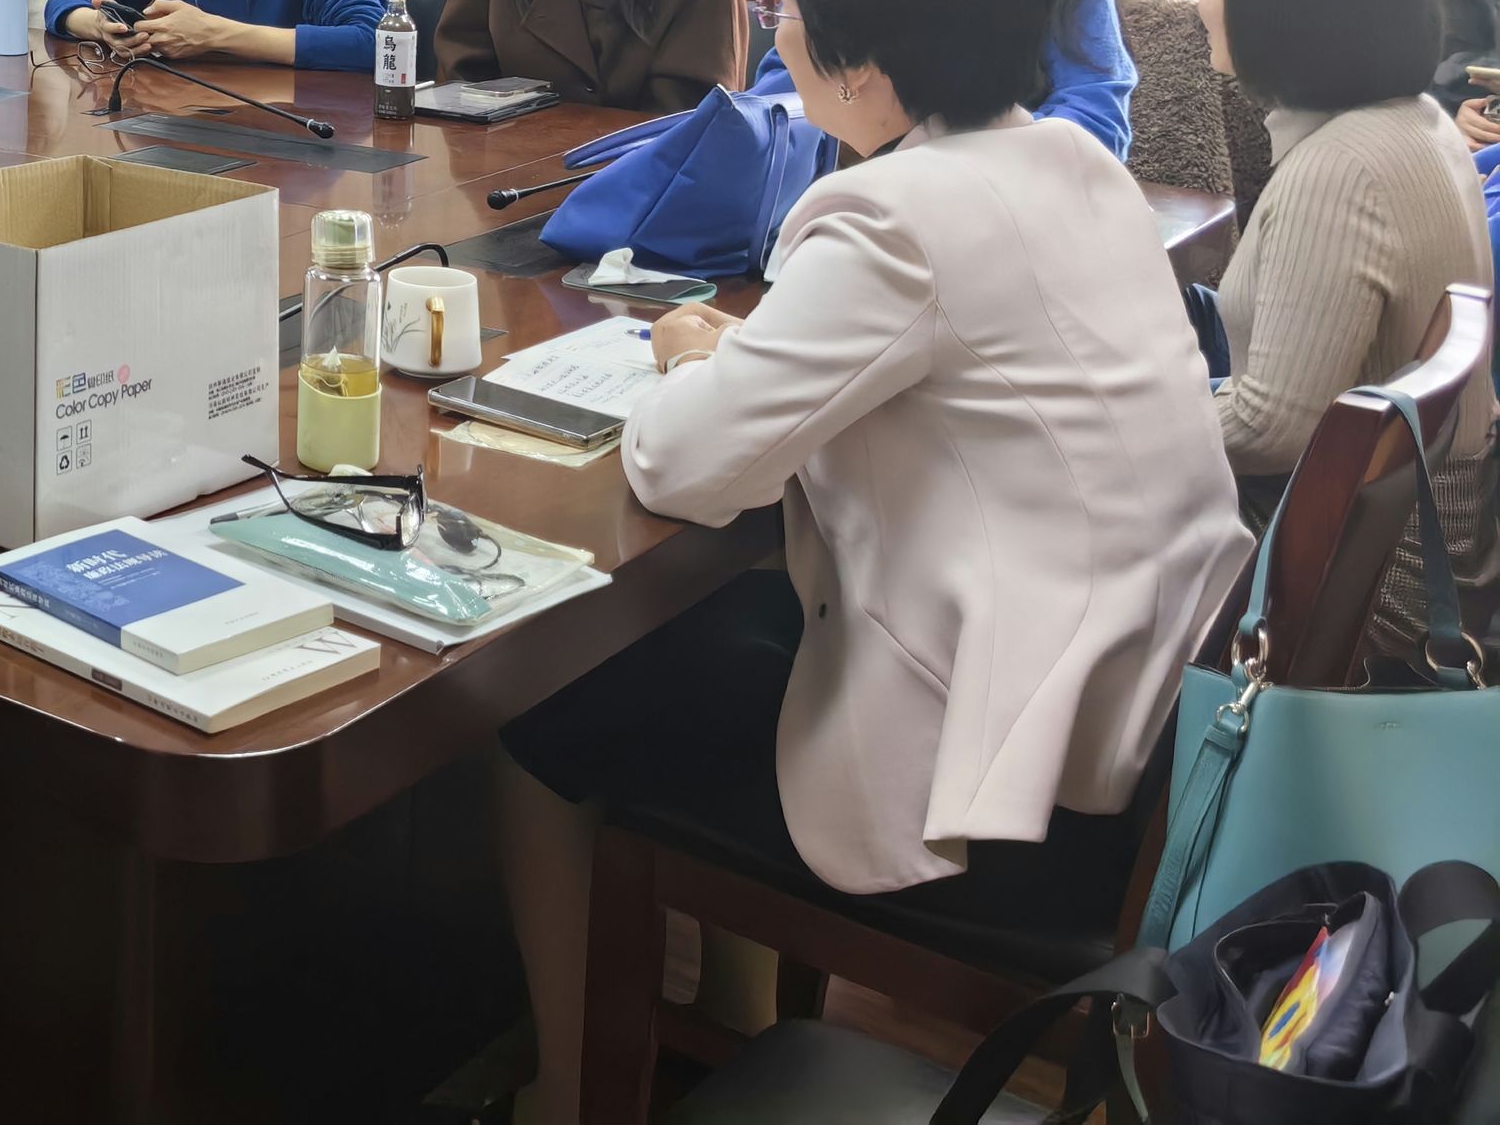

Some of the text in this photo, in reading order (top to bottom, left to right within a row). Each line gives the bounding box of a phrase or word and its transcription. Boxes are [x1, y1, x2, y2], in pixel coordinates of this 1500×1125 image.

[55, 378, 152, 419] Color Copy Paper
